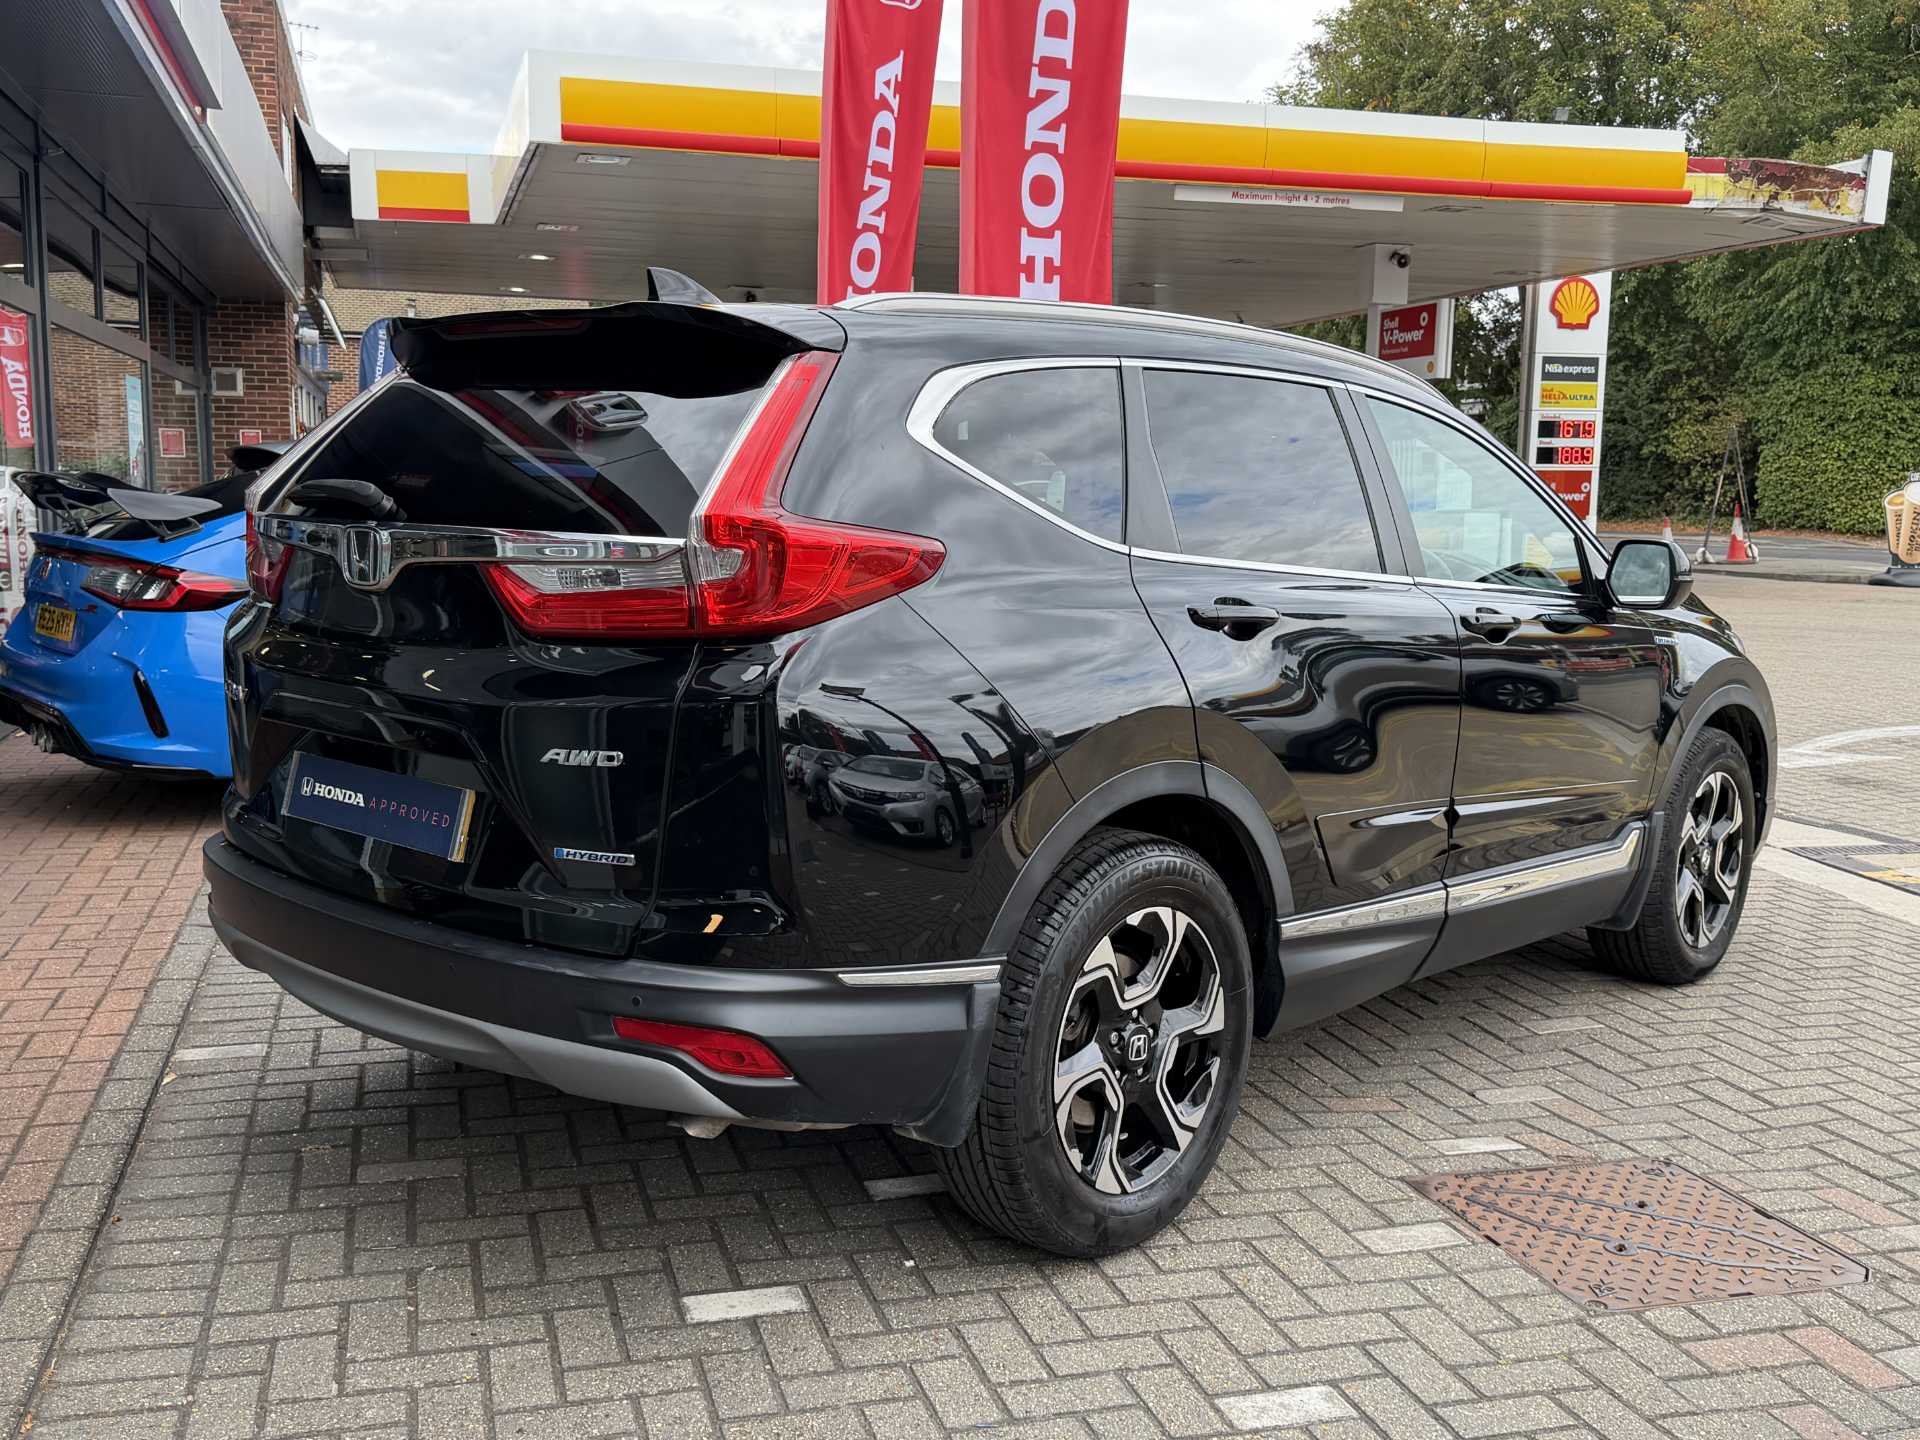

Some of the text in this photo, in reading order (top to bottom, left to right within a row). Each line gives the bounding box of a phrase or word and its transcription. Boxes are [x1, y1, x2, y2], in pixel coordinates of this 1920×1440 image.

[1231, 191, 1273, 201] Maximum
[1275, 192, 1301, 203] height
[1322, 196, 1351, 205] metres
[1383, 316, 1399, 329] Shell
[1383, 328, 1425, 345] V-Power
[1563, 365, 1596, 376] express
[540, 748, 624, 767] AWD
[313, 782, 451, 829] HONDA APPROVED
[565, 849, 628, 865] HYBRID
